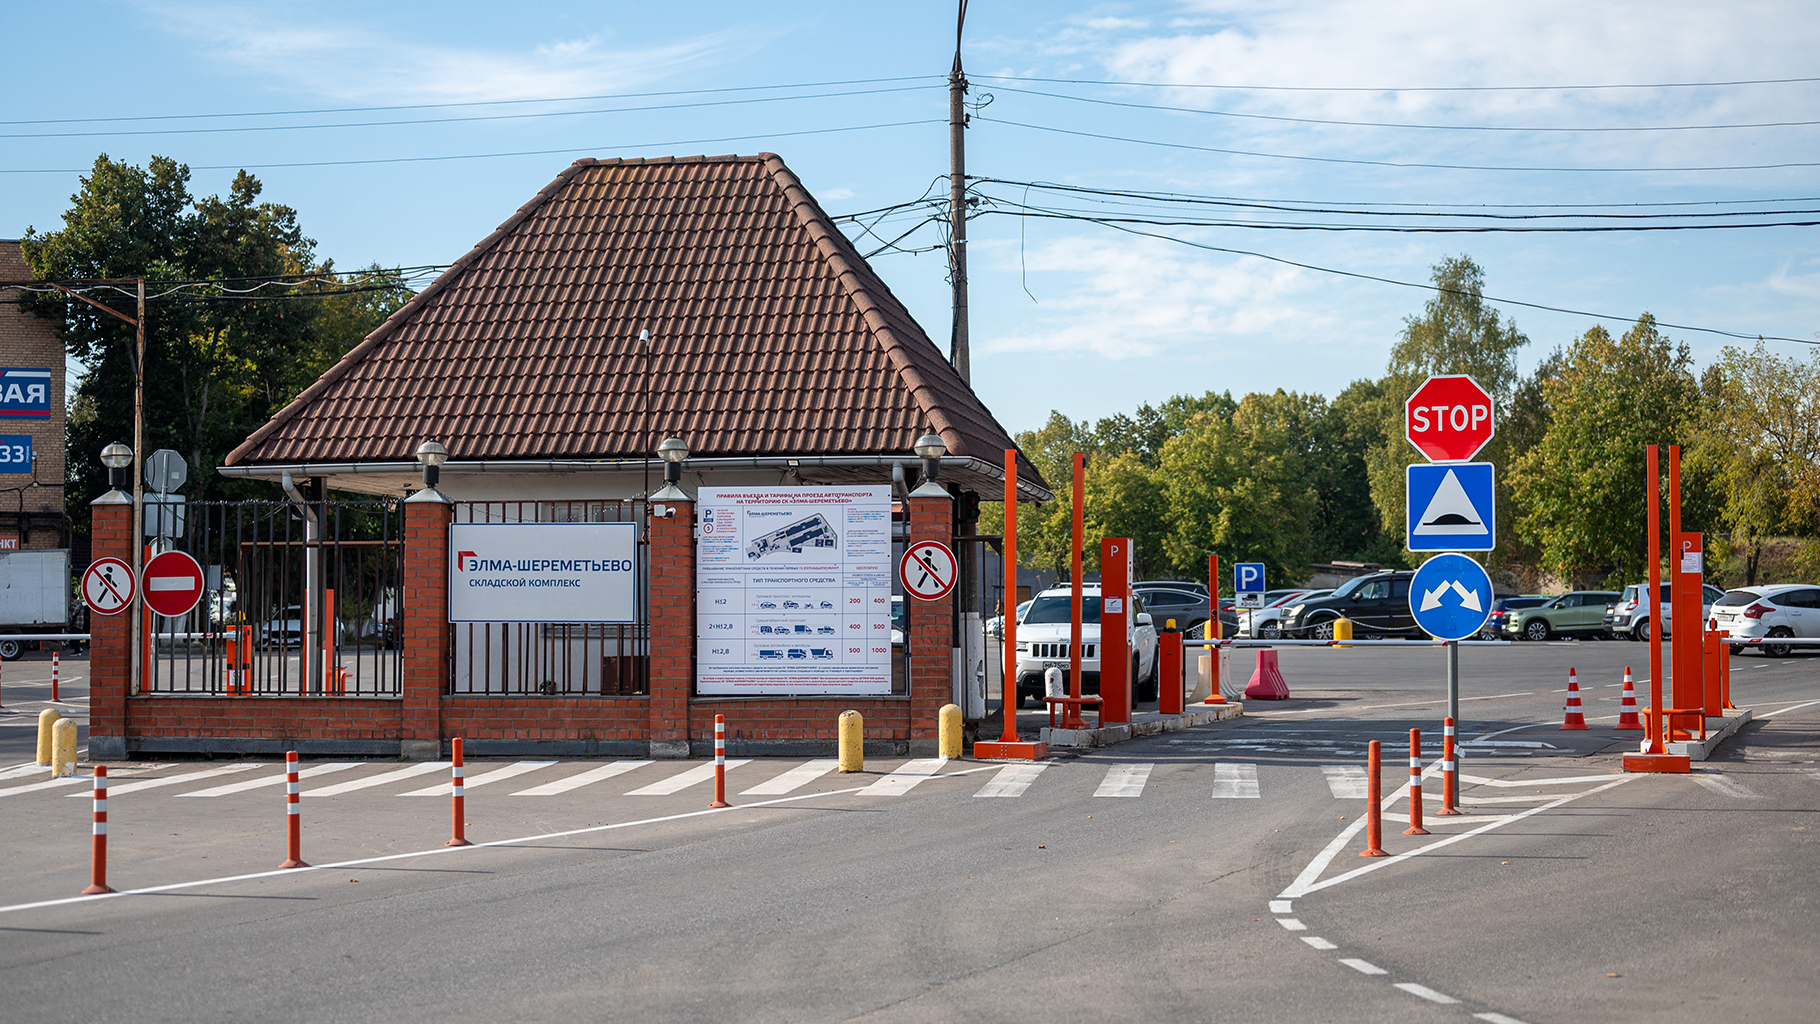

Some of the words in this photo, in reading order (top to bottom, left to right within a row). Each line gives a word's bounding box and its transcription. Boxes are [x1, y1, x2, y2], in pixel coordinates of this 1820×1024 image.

[0, 384, 45, 404] АЯ
[1412, 404, 1488, 432] STOP
[706, 509, 712, 518] P
[1111, 545, 1119, 557] P
[469, 560, 632, 572] ЭЛМА-ШЕРЕМЕТЬЕВО
[469, 578, 526, 588] СКЛАДСКОЙ
[1242, 566, 1258, 590] P
